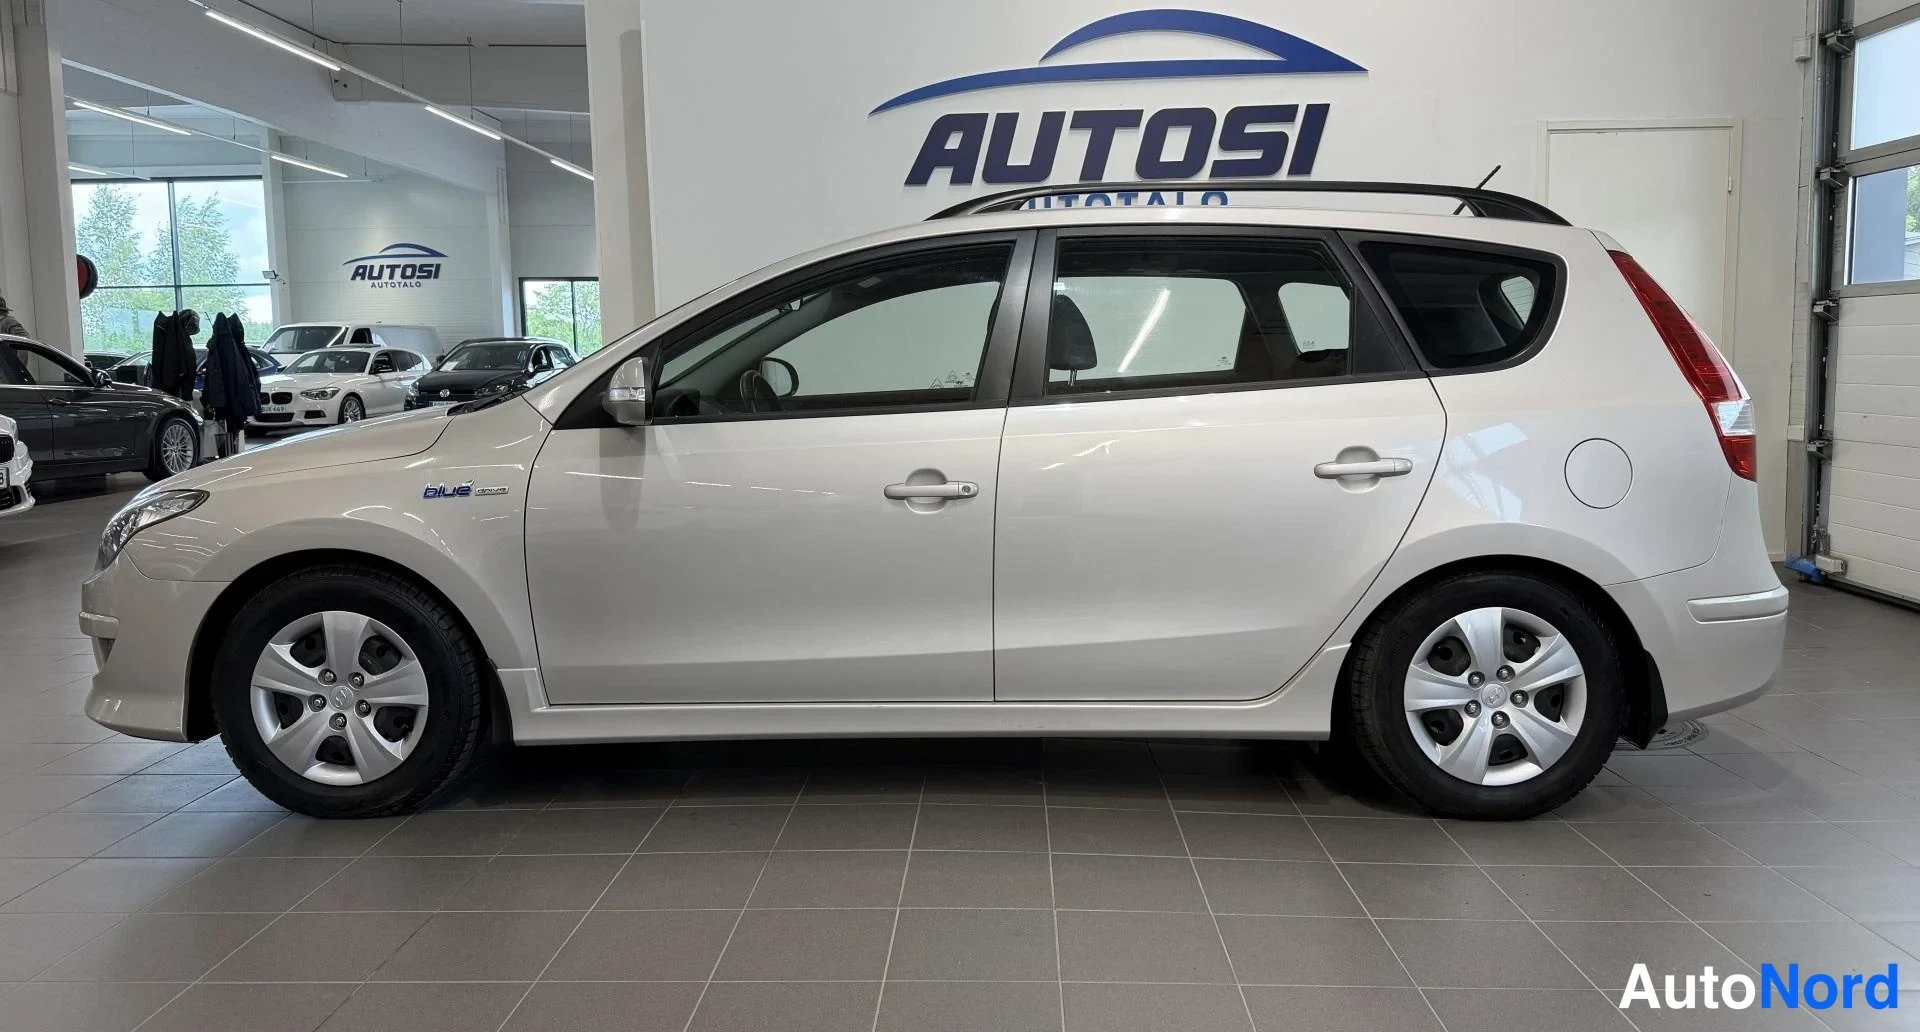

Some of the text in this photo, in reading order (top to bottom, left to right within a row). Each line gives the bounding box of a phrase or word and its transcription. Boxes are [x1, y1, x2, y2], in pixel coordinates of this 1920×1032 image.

[904, 103, 1330, 186] AUTOSI
[350, 263, 442, 281] AUTOSI
[370, 281, 422, 289] AUTOTALO
[423, 482, 473, 499] blue
